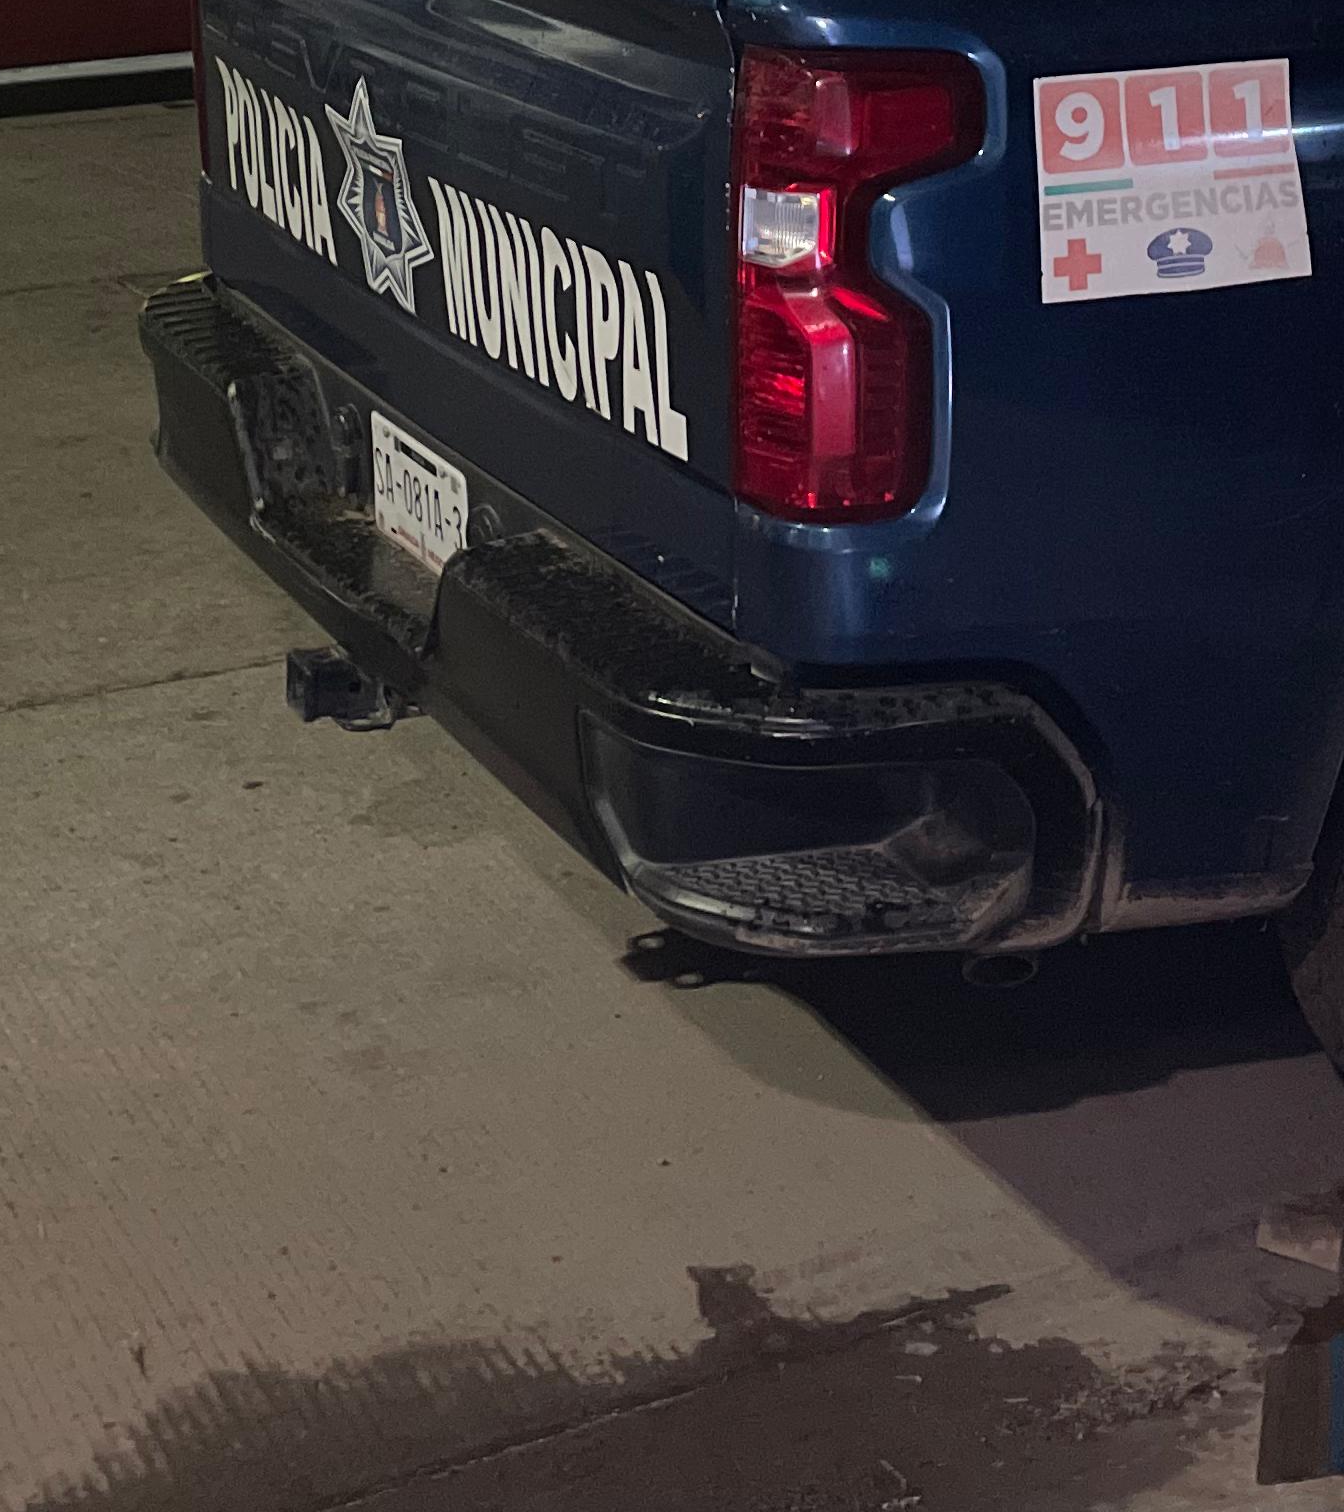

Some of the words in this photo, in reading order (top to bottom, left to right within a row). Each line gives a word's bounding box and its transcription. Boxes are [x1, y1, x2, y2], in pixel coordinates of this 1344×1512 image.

[1054, 79, 1264, 162] 911
[1042, 179, 1299, 232] EMERGENCIAS
[214, 55, 338, 266] POLICIA
[427, 175, 689, 462] MUNICIPAL
